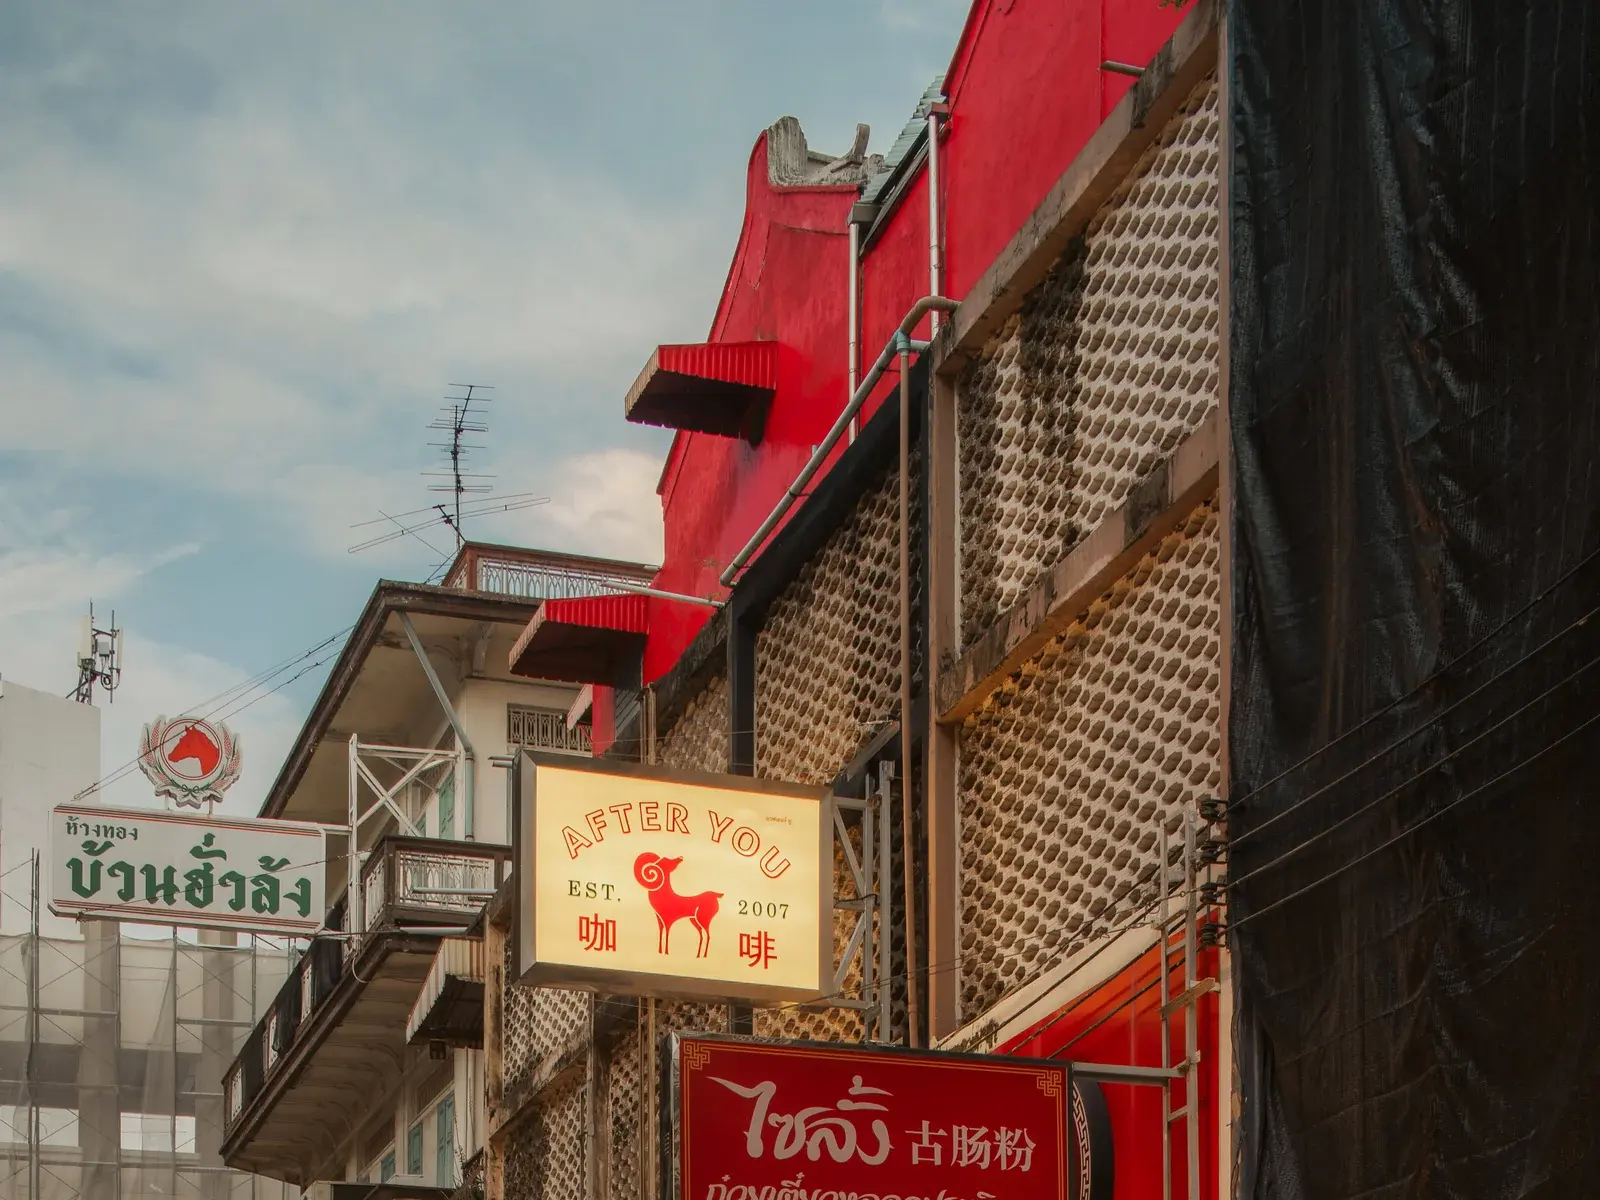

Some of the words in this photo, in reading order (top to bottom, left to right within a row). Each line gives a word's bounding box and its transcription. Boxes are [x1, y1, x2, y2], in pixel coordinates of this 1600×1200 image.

[65, 816, 138, 840] ห้างทอง
[561, 801, 690, 859] AFTER
[708, 810, 791, 879] YOU
[65, 832, 311, 918] บ้วนฮั่วล้ง
[567, 879, 621, 902] EST.
[738, 899, 789, 919] 2007
[578, 913, 617, 952] 咖
[739, 931, 778, 970] 啡
[905, 1120, 1036, 1172] 古肠粉
